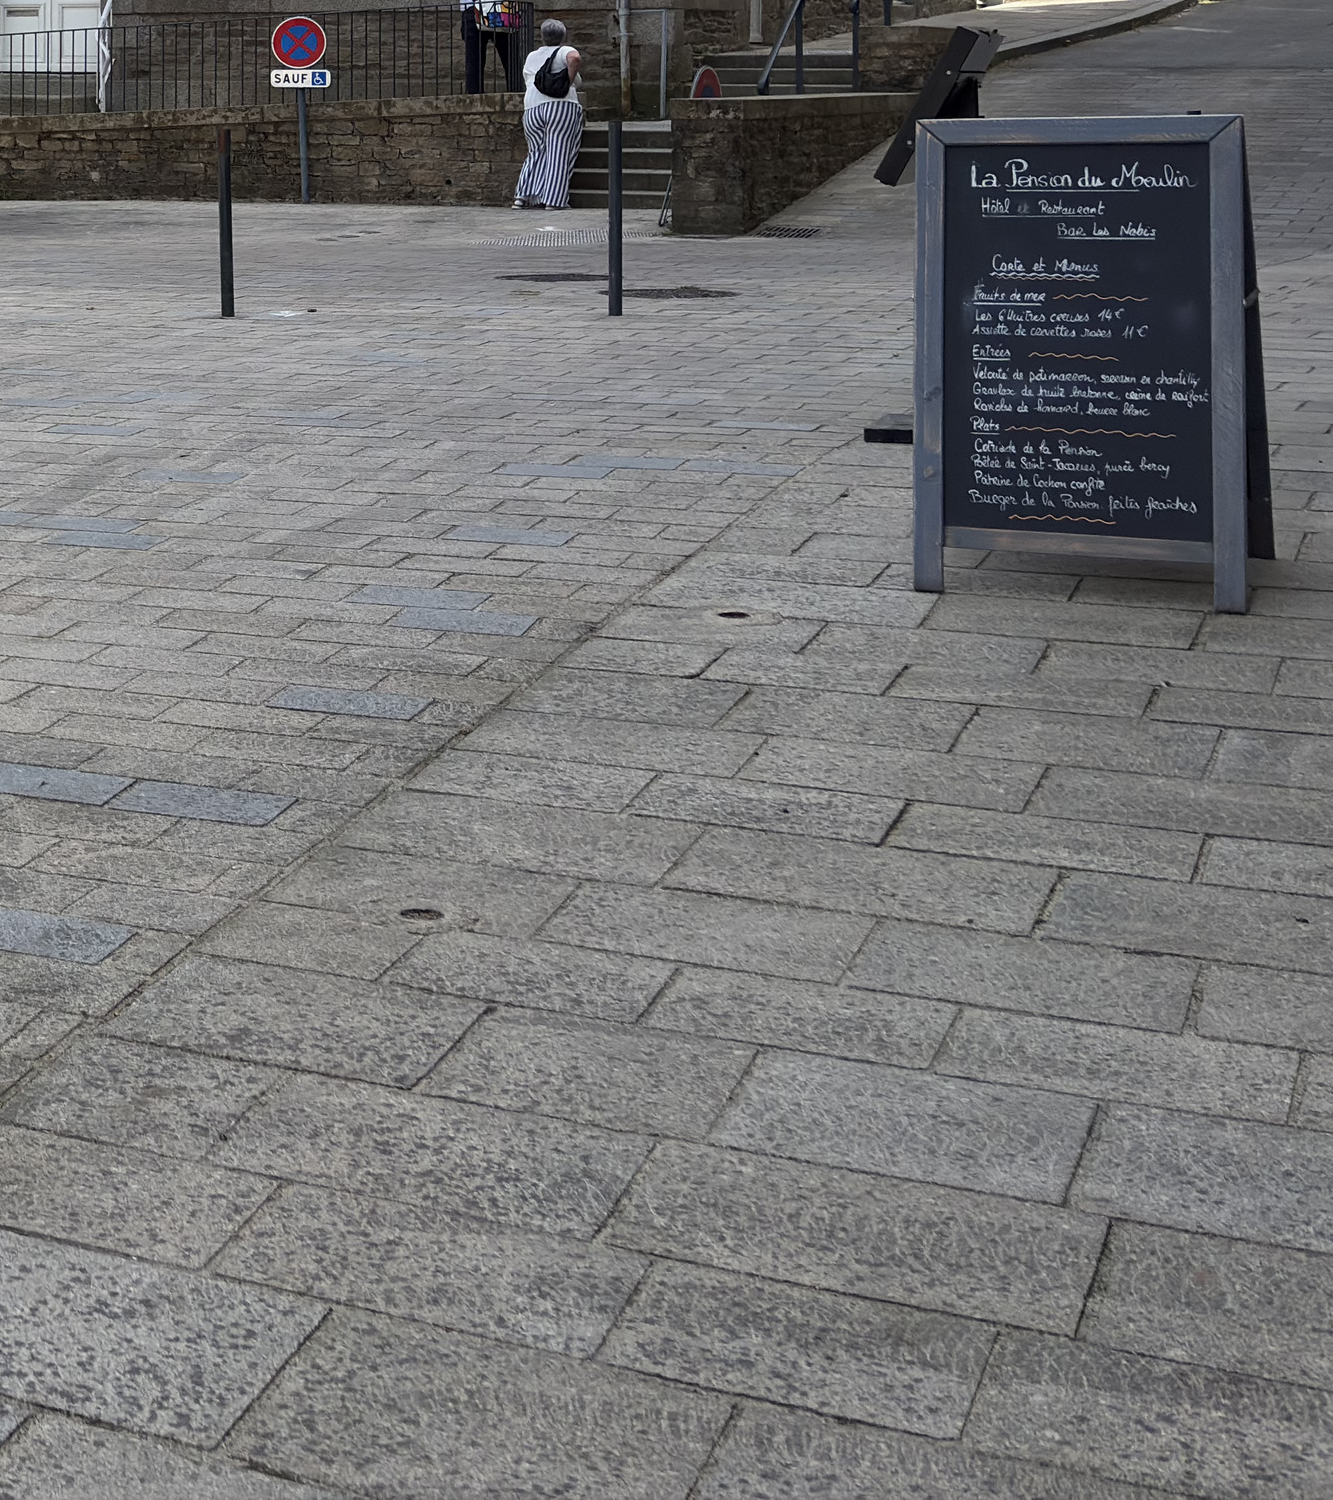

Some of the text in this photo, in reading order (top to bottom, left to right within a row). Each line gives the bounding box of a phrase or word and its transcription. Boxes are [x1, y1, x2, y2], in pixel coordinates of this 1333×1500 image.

[274, 73, 308, 84] SAUF
[970, 159, 1197, 188] La Pension du Moulin
[981, 197, 1010, 214] Hôtel
[1038, 199, 1105, 215] Restaurant
[1119, 221, 1157, 237] Nabis
[992, 253, 1099, 273] Carte et Menus
[973, 286, 1046, 301] Fruits de mer
[975, 309, 993, 321] Les
[1050, 312, 1090, 323] creuses
[1014, 324, 1027, 337] de
[1080, 328, 1112, 338] roses
[972, 344, 1012, 357] Entrées
[972, 362, 1010, 380] Velouté
[1013, 368, 1024, 380] de
[1020, 384, 1034, 397] de
[1155, 388, 1167, 401] de
[1017, 400, 1029, 413] de
[1122, 401, 1151, 416] blanc
[969, 416, 1000, 431] Plats
[1023, 441, 1034, 454] de
[1039, 439, 1052, 455] la
[1058, 439, 1103, 457] Pension
[1005, 456, 1016, 469] de
[1017, 473, 1031, 488] de
[968, 489, 1018, 512] Burger
[1021, 490, 1036, 506] de
[1042, 491, 1056, 508] la
